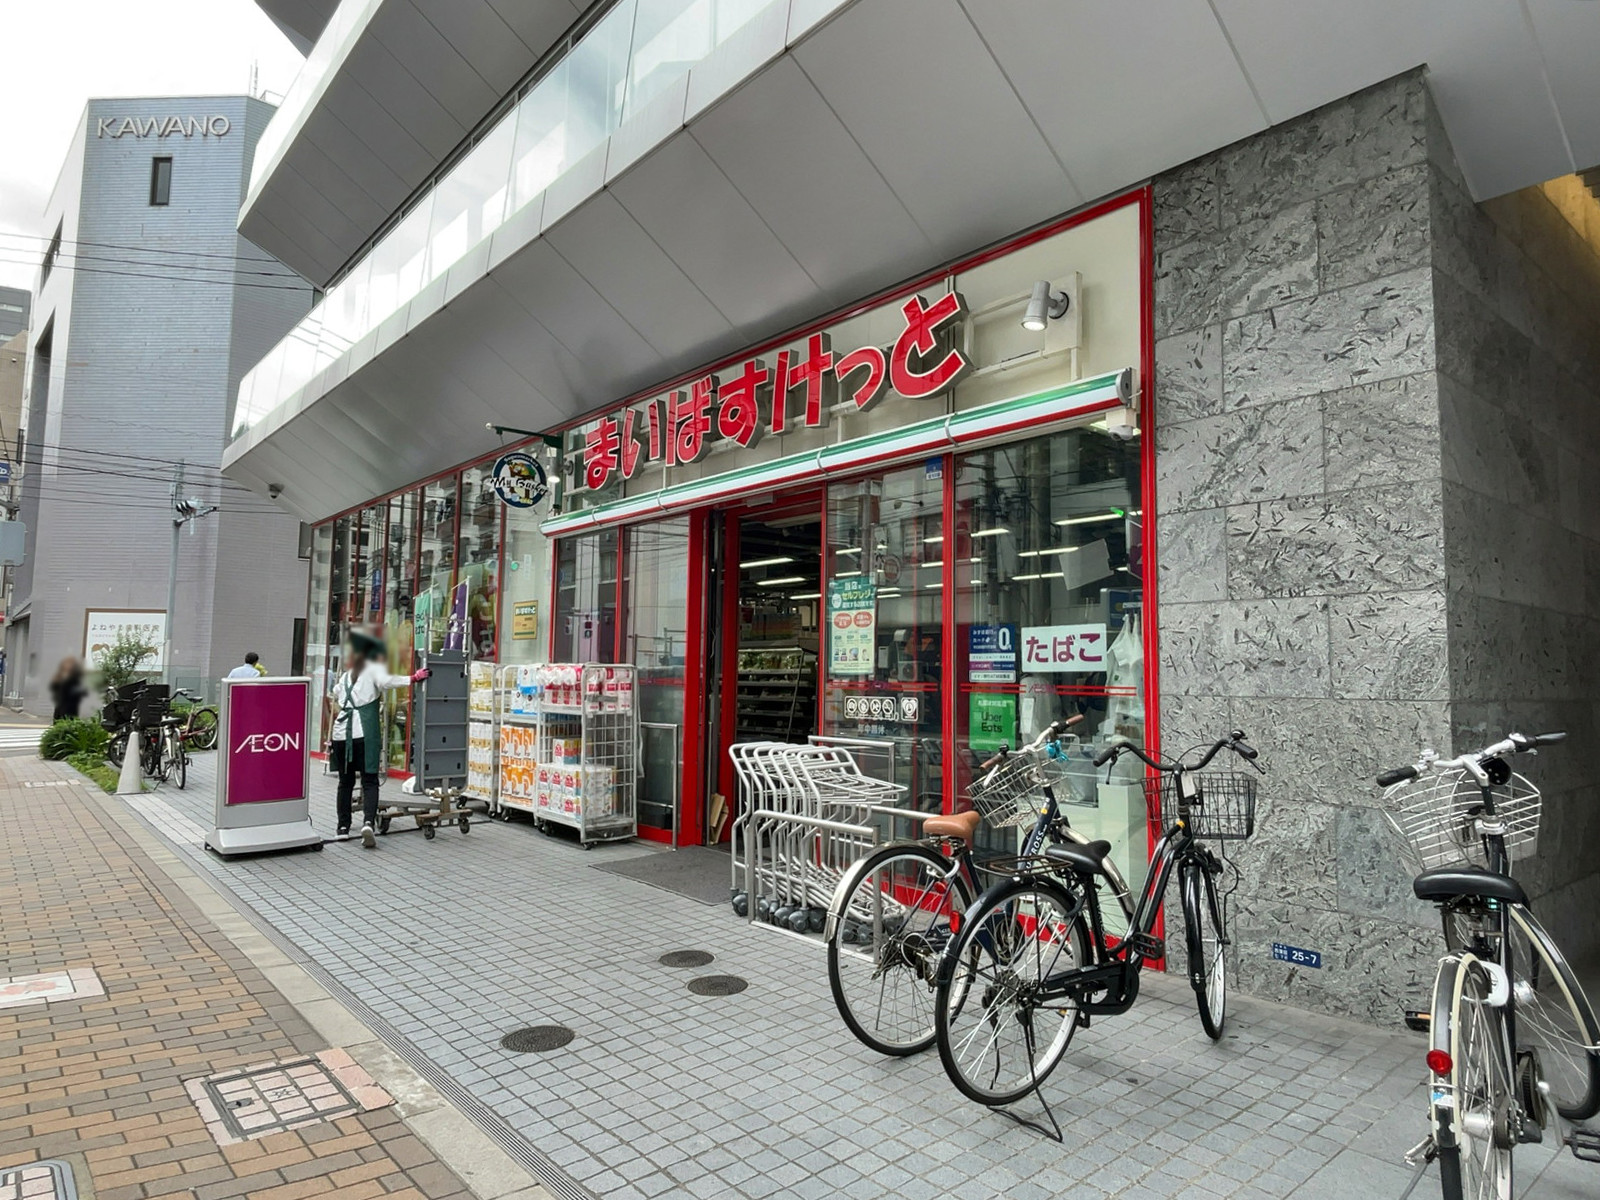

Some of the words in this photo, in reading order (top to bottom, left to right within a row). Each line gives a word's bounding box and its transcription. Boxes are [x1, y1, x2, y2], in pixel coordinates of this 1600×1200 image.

[97, 115, 231, 138] KAWANO
[583, 290, 967, 490] まいばすけっと
[1026, 633, 1102, 663] たばこ
[981, 711, 1002, 723] Uber
[981, 722, 1002, 733] Eats
[1292, 950, 1317, 964] 25-7
